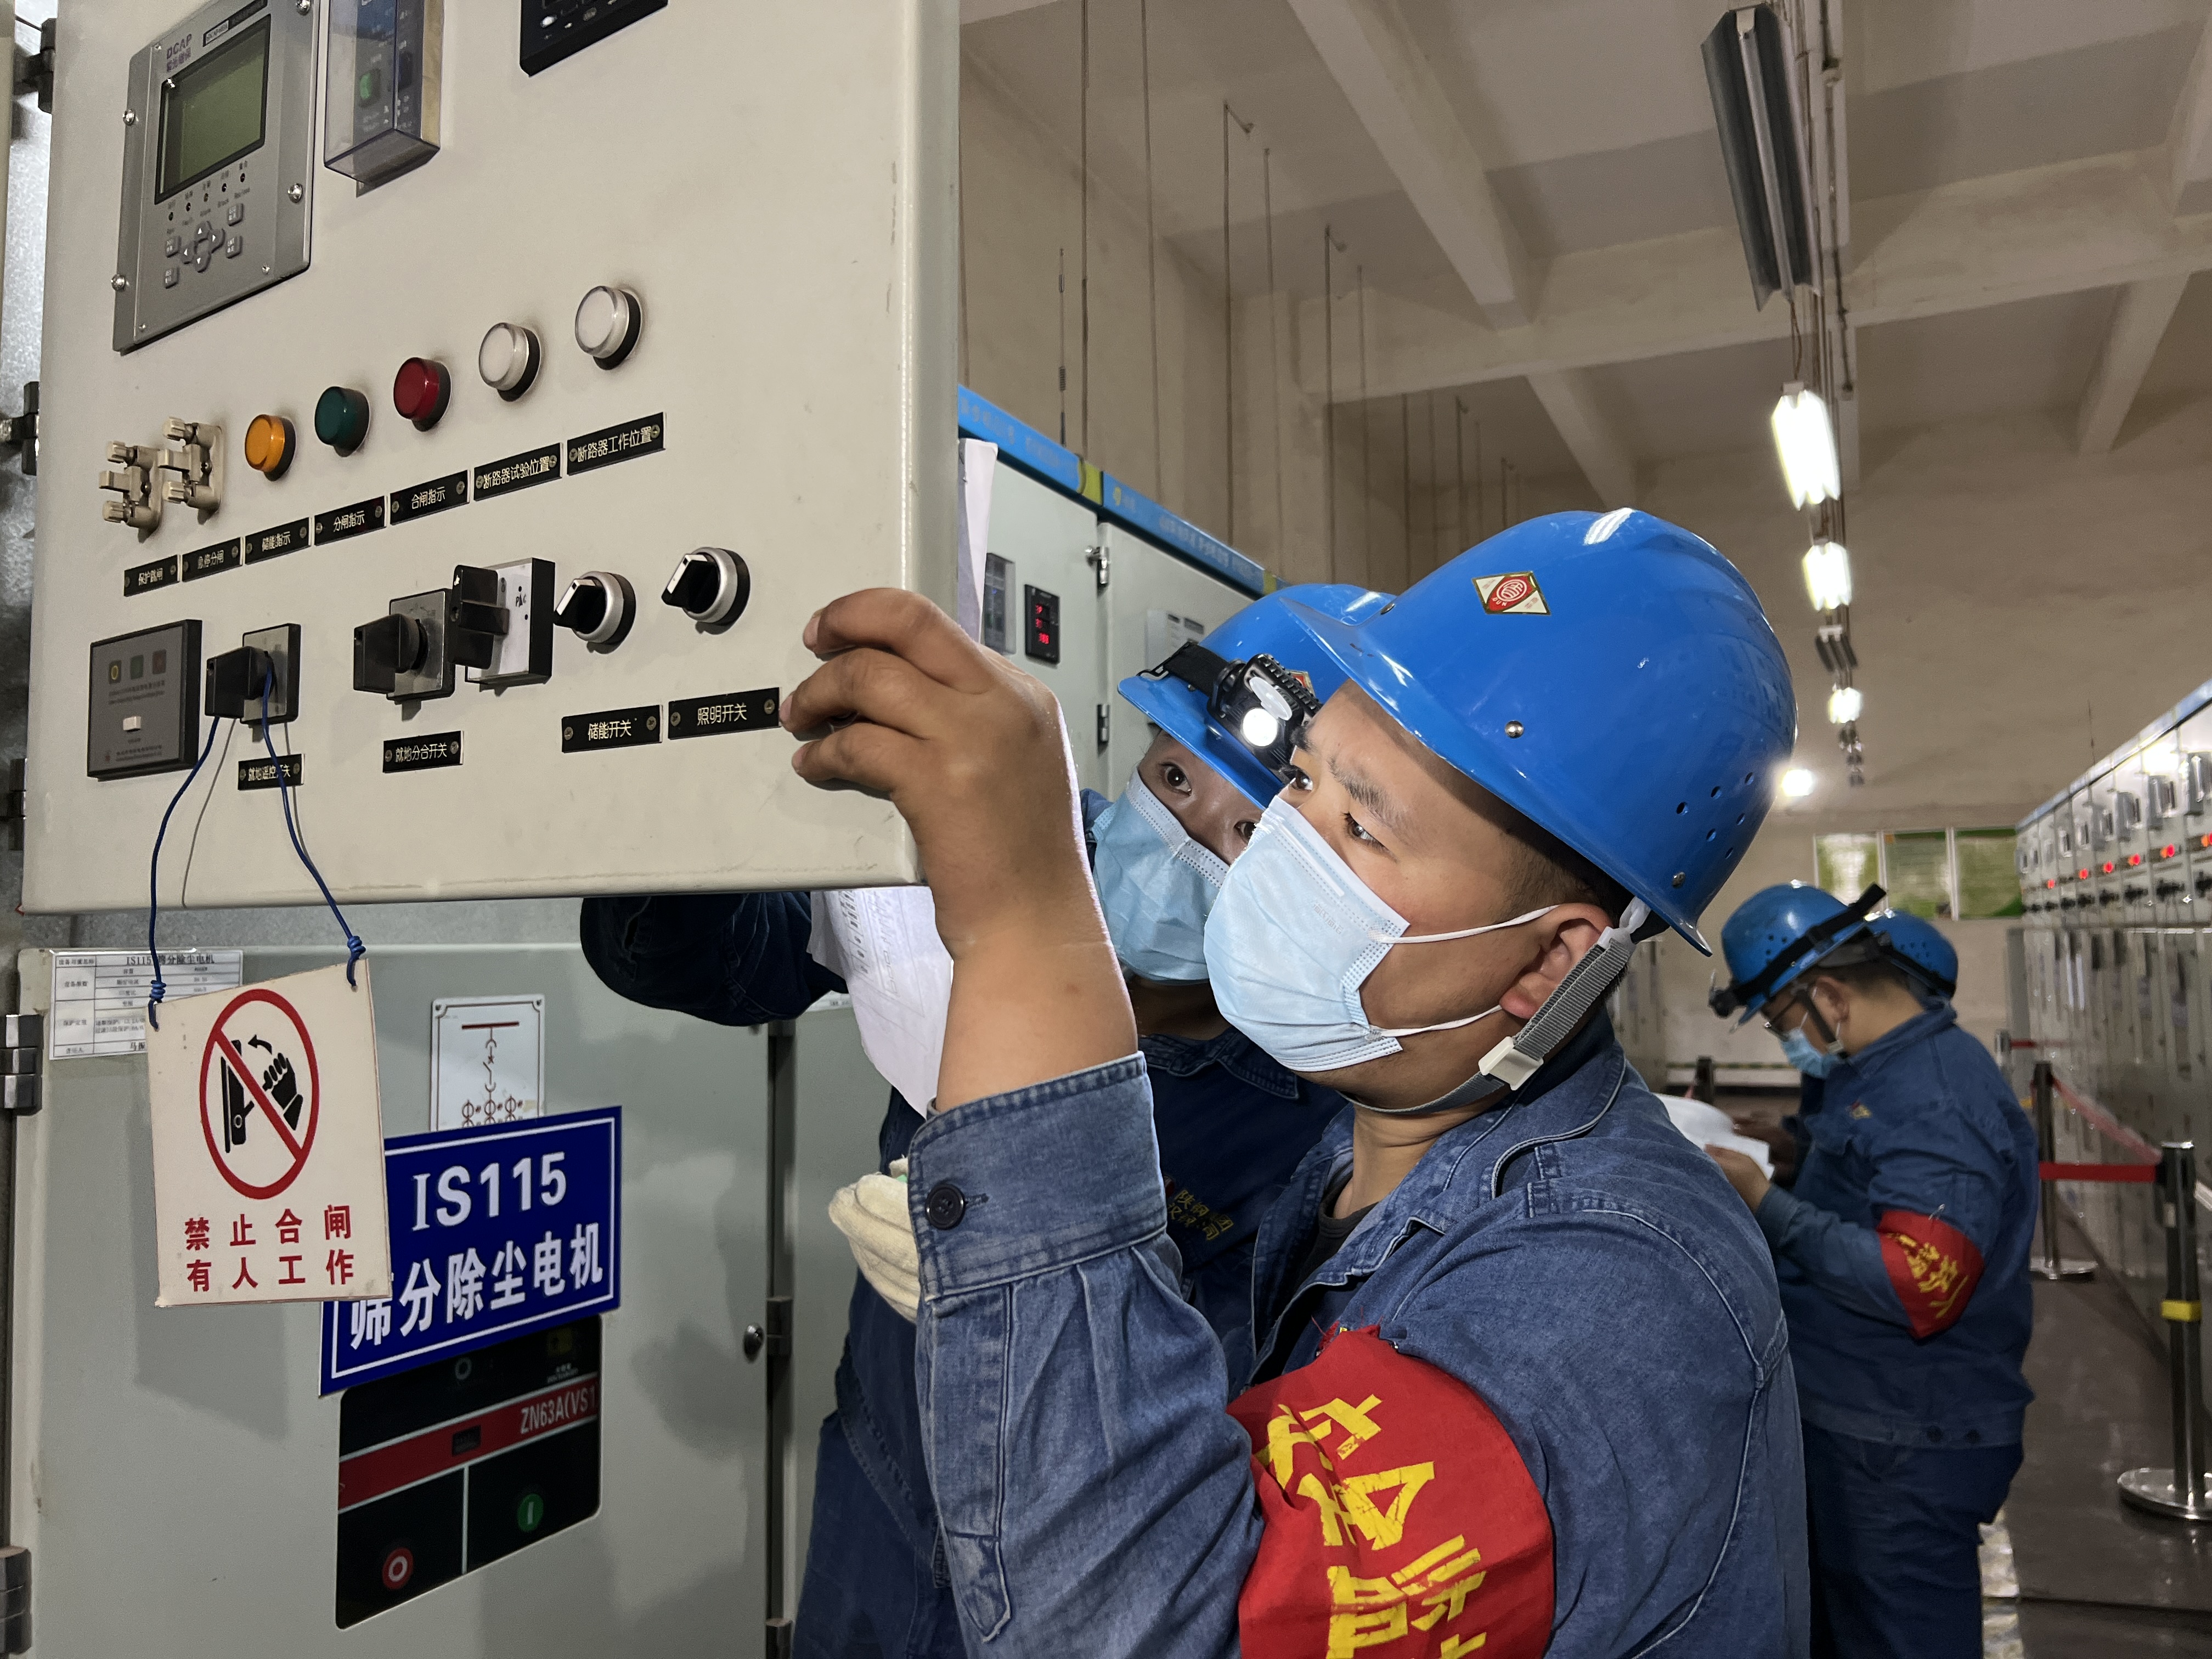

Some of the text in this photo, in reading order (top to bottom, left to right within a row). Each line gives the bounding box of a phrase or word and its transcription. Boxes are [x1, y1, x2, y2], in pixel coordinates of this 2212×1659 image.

[166, 33, 192, 59] DCAP
[577, 426, 653, 462] 断路器工作位置
[483, 455, 550, 490] 断路器试验位置
[411, 487, 446, 509] 合闸指示
[333, 510, 365, 532] 分闸指示
[262, 532, 291, 552] 储能指示
[197, 550, 224, 570] 急停分闸
[138, 567, 163, 586] 保护跳闸
[697, 702, 748, 726] 照明开关
[588, 720, 633, 742] 储能开关
[394, 742, 448, 763] 就地分合开关
[247, 763, 291, 782] 就地遥控关
[126, 956, 151, 966] IS115
[411, 1151, 567, 1232] IS115
[1167, 1202, 1221, 1241] 汉钢司
[1173, 1189, 1234, 1233] 陕钢团
[184, 1204, 352, 1251] 禁止合闸
[187, 1249, 354, 1293] 有人工作
[1254, 1393, 1487, 1659] 安全监
